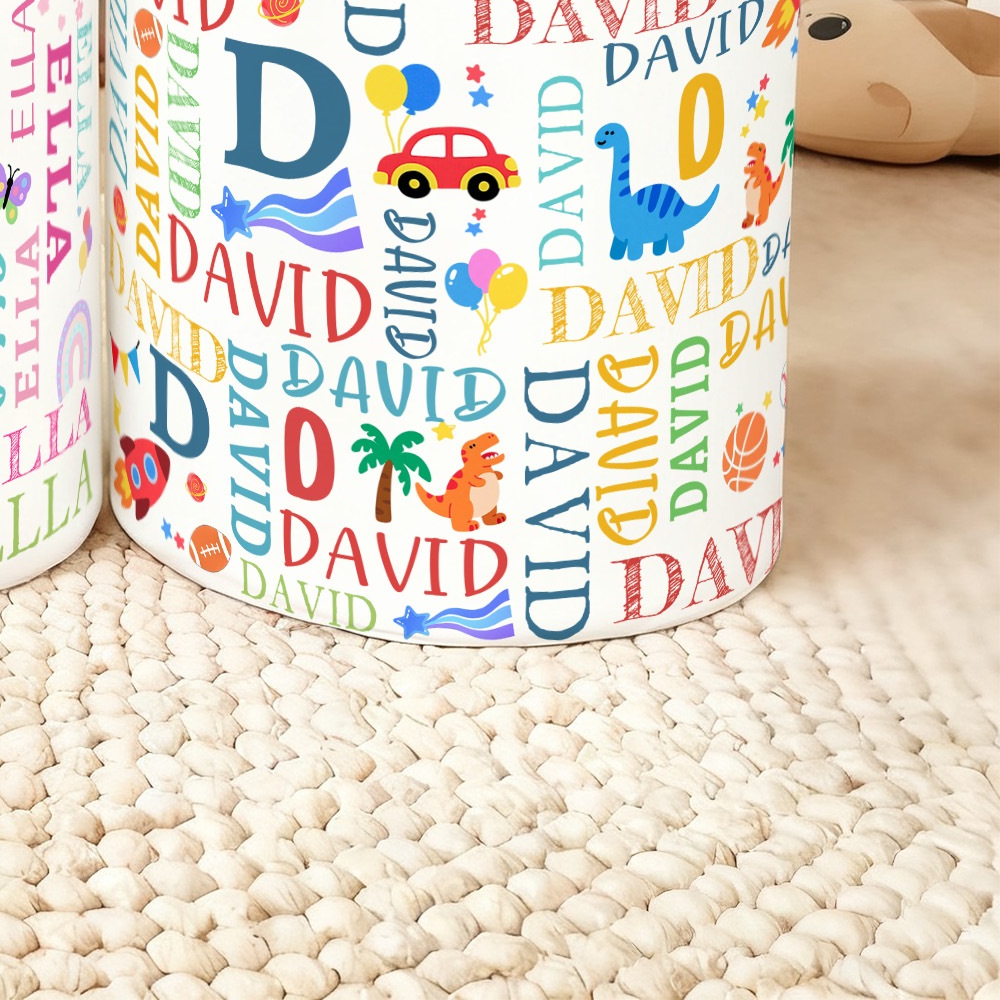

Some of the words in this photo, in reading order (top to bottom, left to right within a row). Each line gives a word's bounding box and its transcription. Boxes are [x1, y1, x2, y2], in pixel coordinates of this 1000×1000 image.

[46, 34, 72, 284] ELLA
[135, 64, 160, 279] DAVID
[167, 24, 201, 219] DAVID
[224, 37, 351, 180] D
[538, 75, 584, 271] DAVID
[15, 225, 40, 408] ELLA
[109, 222, 227, 383] DAVID
[168, 213, 371, 343] DAVID
[383, 208, 437, 359] DAVID
[539, 236, 759, 345] DAVID
[719, 276, 789, 369] DAV
[150, 344, 209, 459] D
[227, 338, 271, 556] DAVID
[280, 344, 506, 422] DAVID
[595, 345, 659, 546] DAVID
[669, 336, 710, 522] DAVID
[280, 509, 508, 597] DAVID
[523, 359, 590, 641] DAVID
[611, 497, 783, 624] DAVI
[240, 557, 377, 632] DAVID
